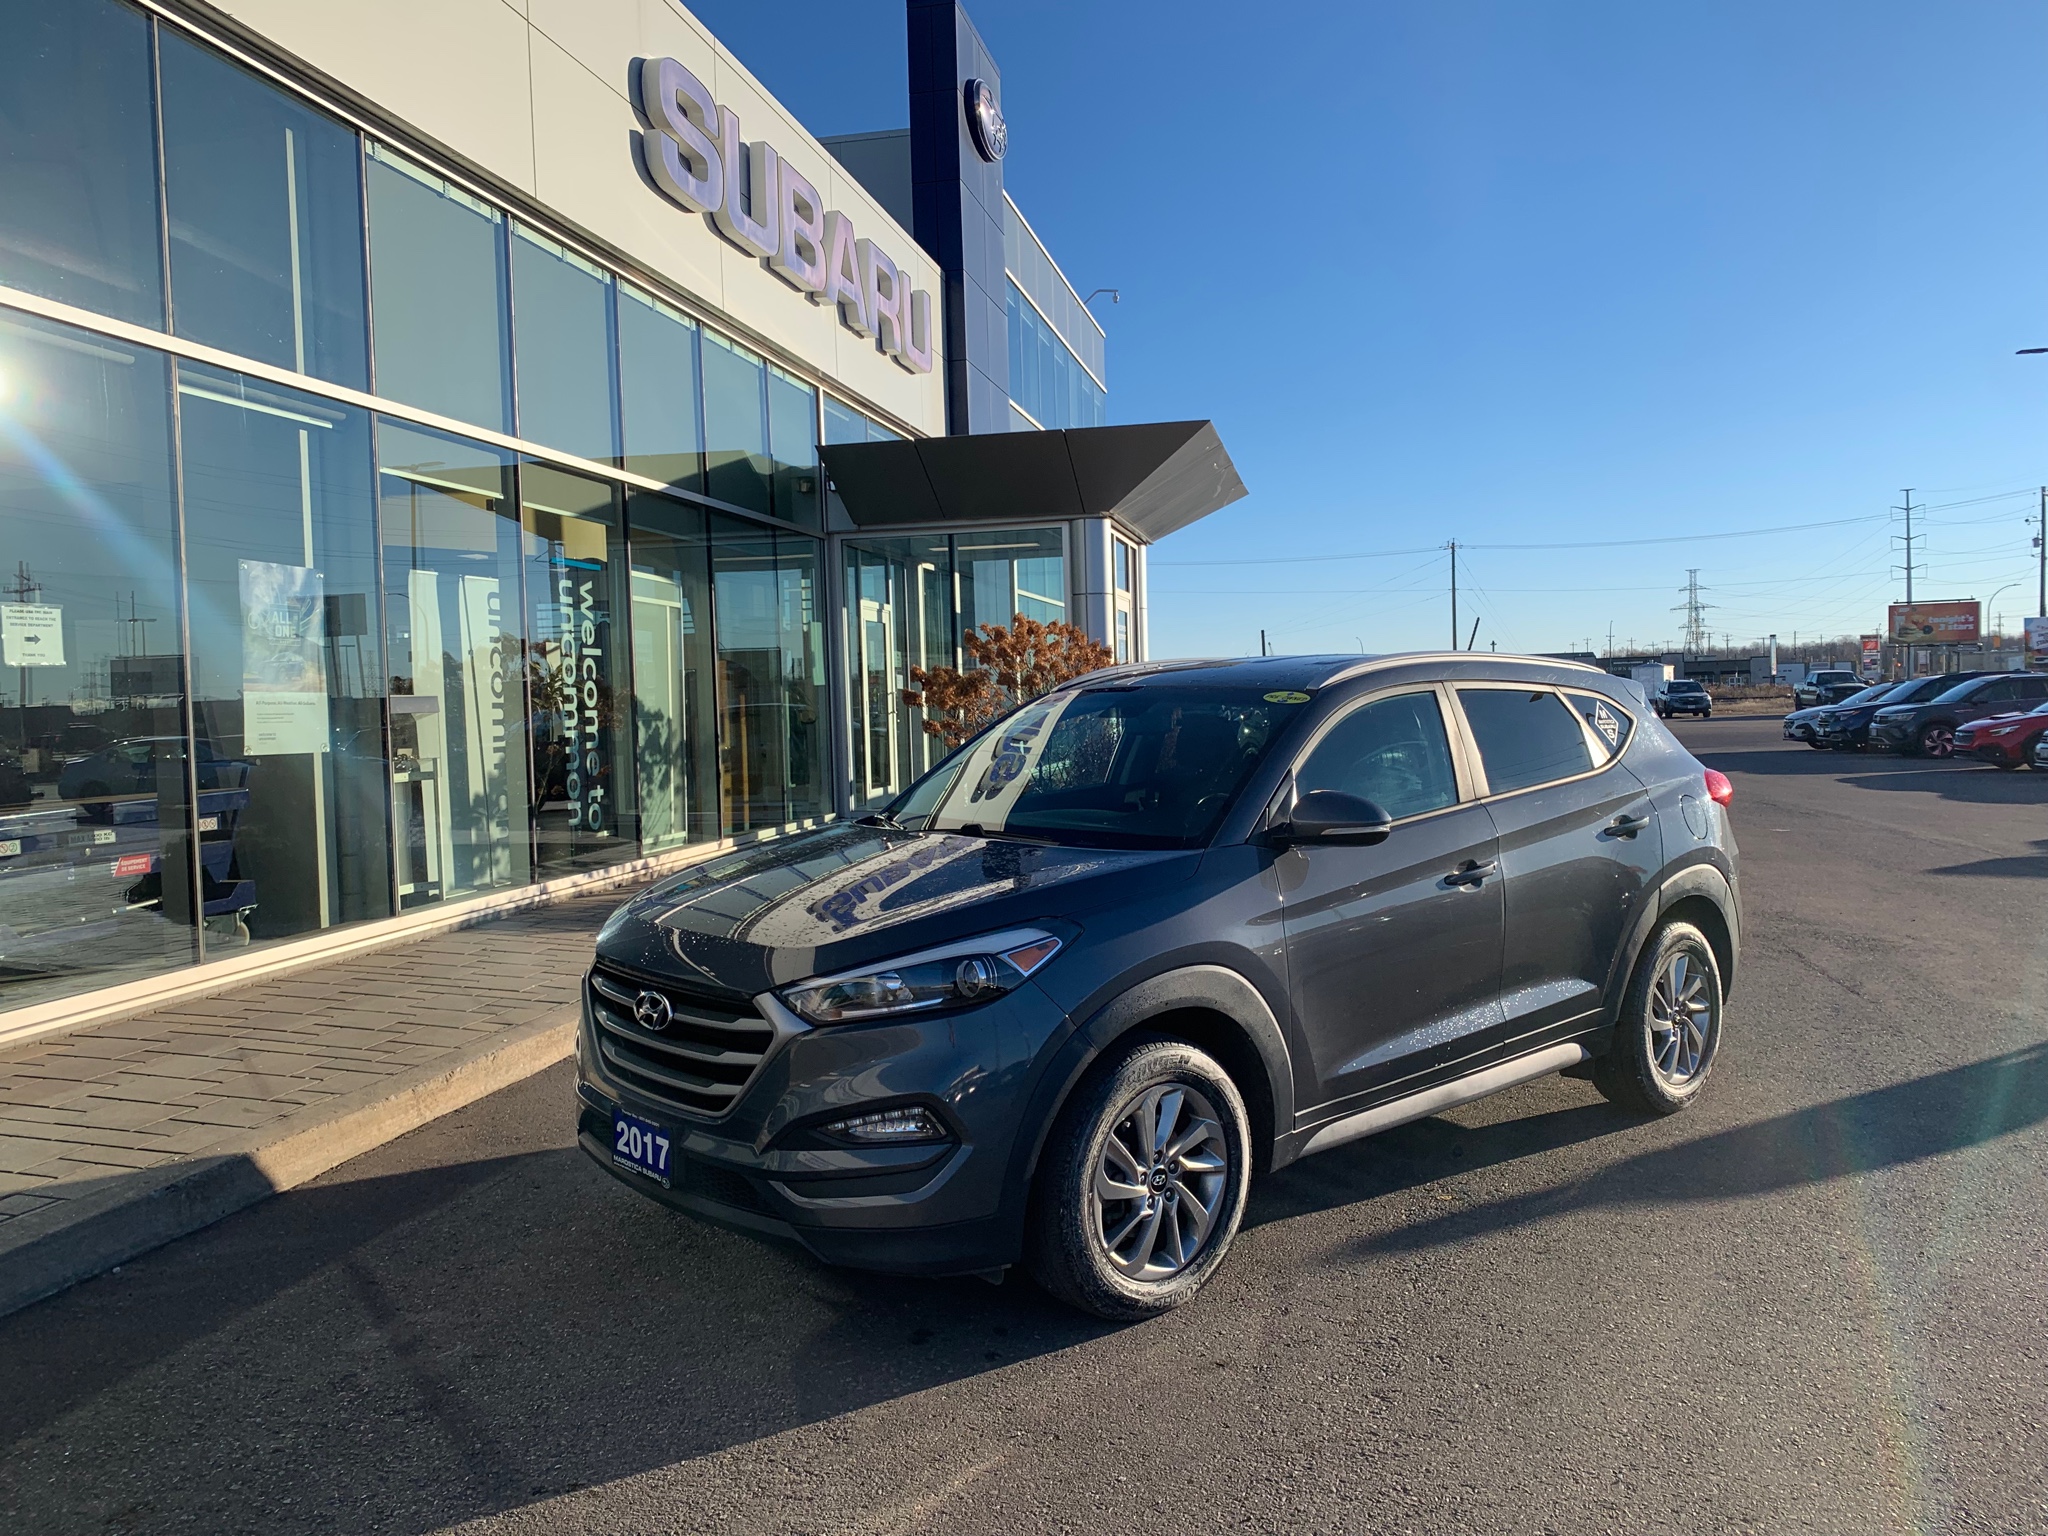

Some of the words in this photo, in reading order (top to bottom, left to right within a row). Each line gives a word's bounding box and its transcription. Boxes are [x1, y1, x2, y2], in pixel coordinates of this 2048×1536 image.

[640, 56, 932, 374] SUBARU
[271, 611, 292, 624] ALL
[1928, 614, 1975, 624] tonight's
[275, 624, 297, 638] ONE
[1948, 623, 1974, 631] stars
[580, 580, 603, 777] welcome
[557, 578, 582, 826] uncommon
[1599, 709, 1608, 719] M
[1607, 729, 1615, 739] S
[587, 785, 604, 832] to
[616, 1120, 669, 1170] 2017
[643, 1168, 662, 1182] SUBARU
